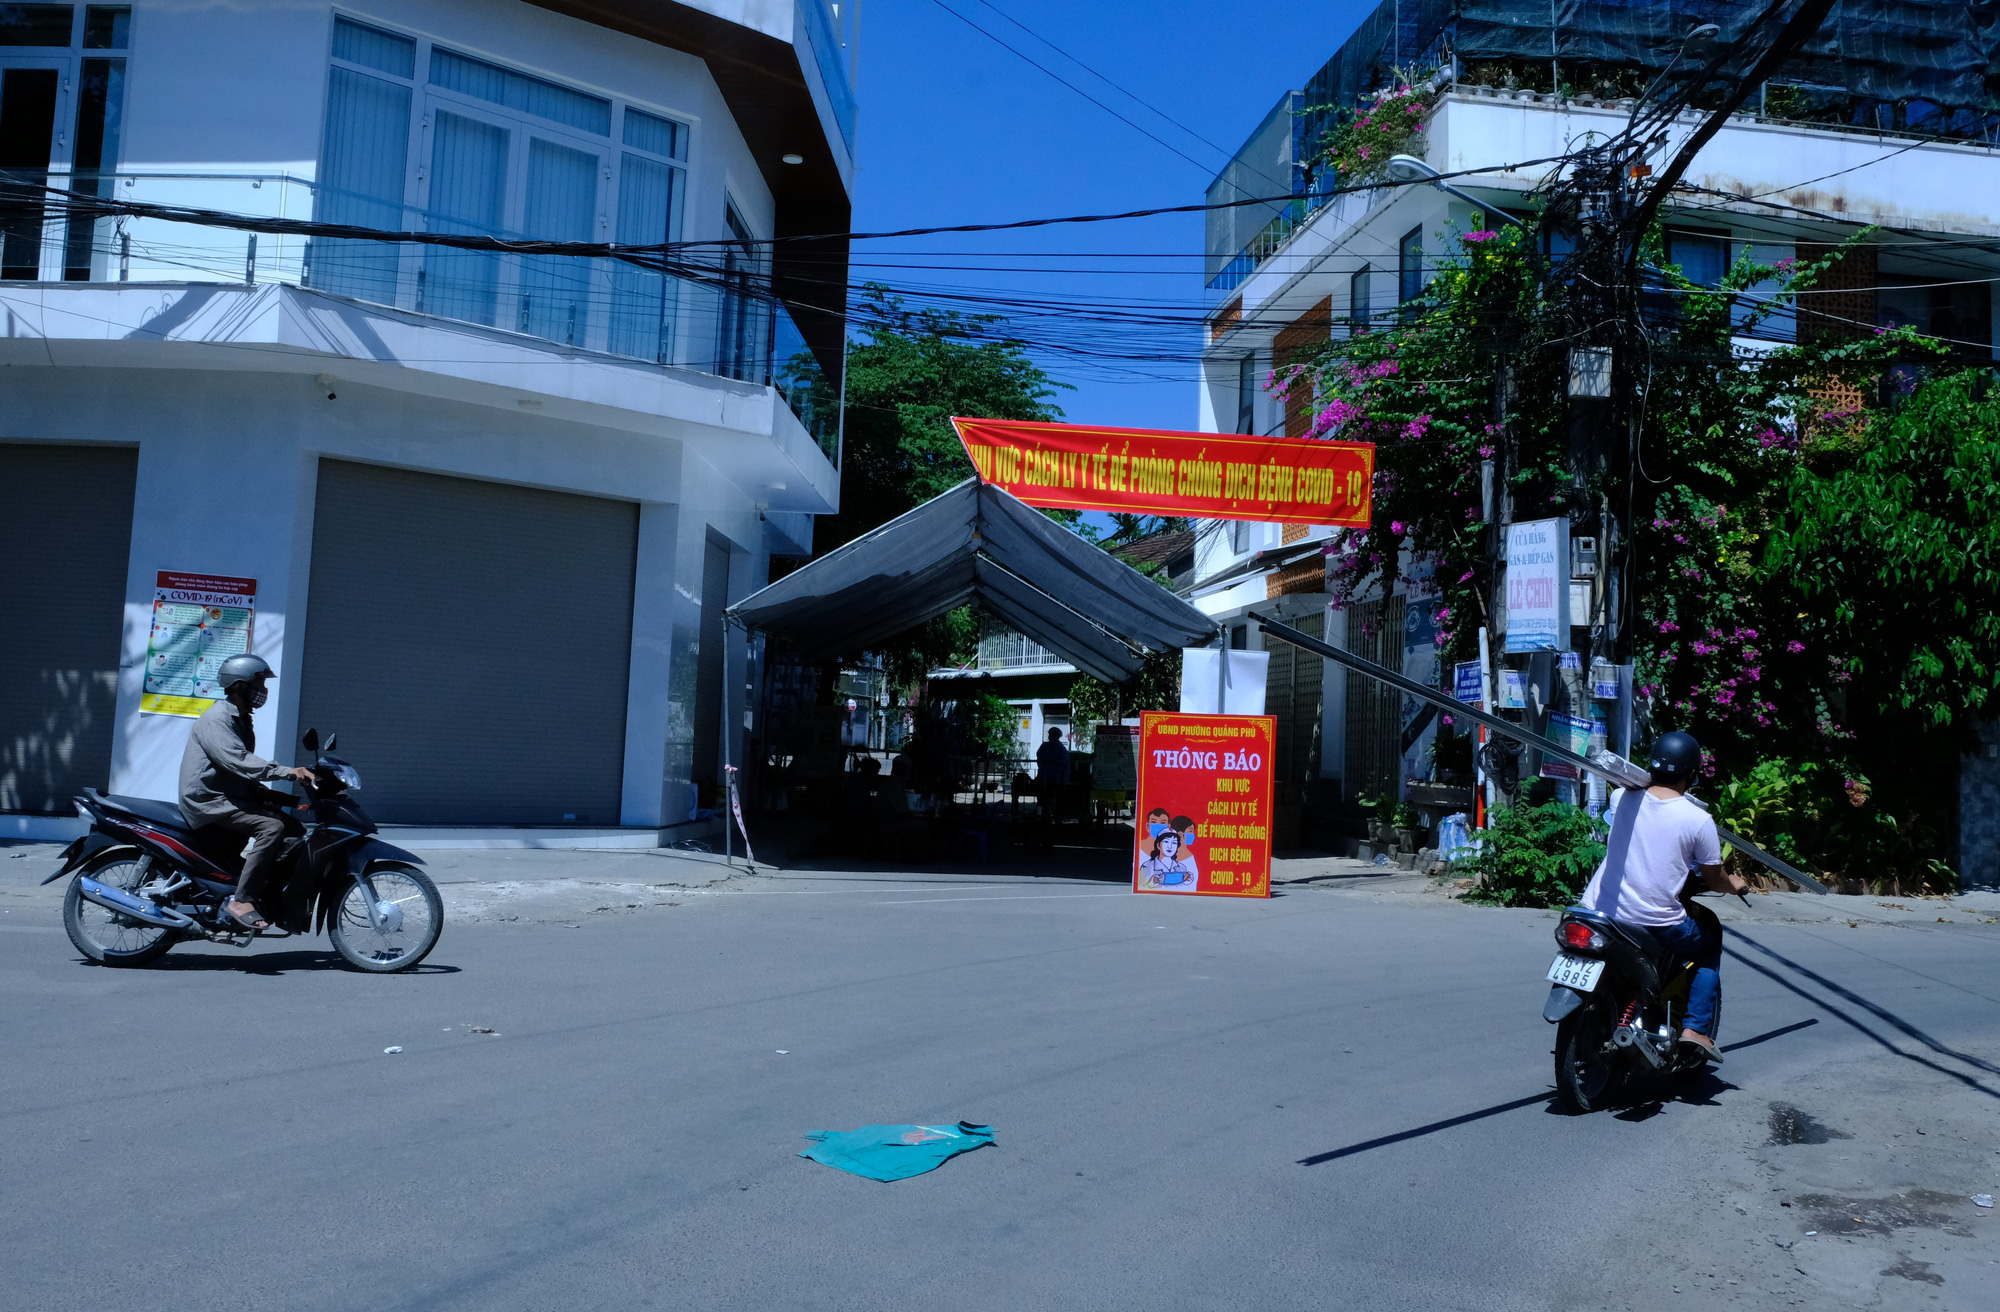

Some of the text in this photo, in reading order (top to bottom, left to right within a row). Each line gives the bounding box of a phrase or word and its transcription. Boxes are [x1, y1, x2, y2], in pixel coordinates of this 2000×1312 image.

[996, 444, 1021, 491] VỰC
[1024, 442, 1060, 487] CÁCH
[1062, 452, 1078, 488] LY
[1081, 453, 1090, 488] Y
[1092, 442, 1109, 490] TẾ
[1110, 440, 1130, 492] ĐỂ
[1130, 448, 1175, 496] PHÒNG
[1178, 447, 1222, 498] CHỐNG
[1224, 462, 1256, 508] DỊCH
[1258, 457, 1294, 510] BỆNH
[1296, 467, 1334, 505] COVID
[1346, 470, 1362, 506] 19
[1158, 724, 1178, 735] UBND
[1180, 724, 1211, 736] PHƯỜNG
[1213, 724, 1238, 737] QUẢNG
[1153, 746, 1261, 771] THÔNG BÁO
[1216, 778, 1250, 796] KHU VỰC
[1208, 798, 1258, 816] CÁCH LY Y TẾ
[1198, 818, 1266, 840] ĐỂ PHÒNG CHỐNG
[1210, 846, 1252, 865] DỊCH BỆNH
[1210, 870, 1234, 885] COVID
[1241, 872, 1251, 886] 19
[1553, 968, 1589, 987] 4985
